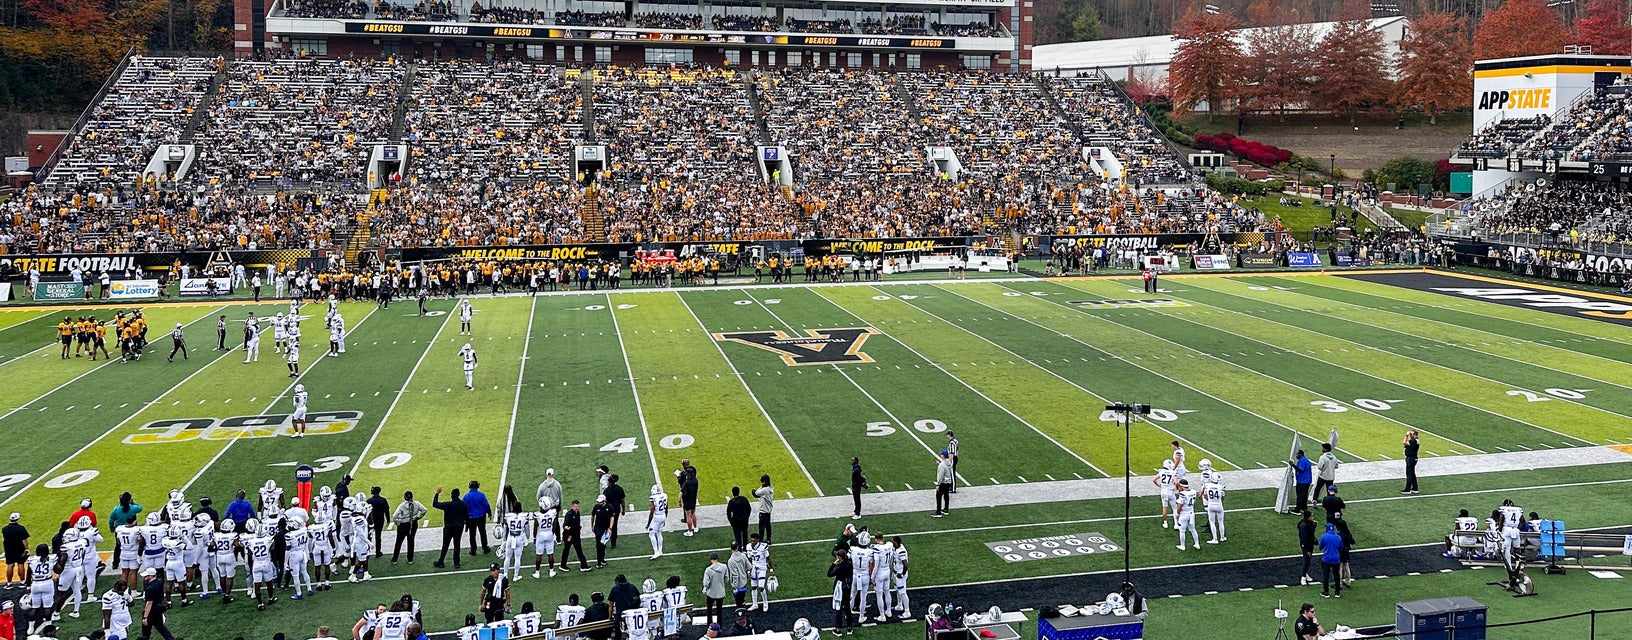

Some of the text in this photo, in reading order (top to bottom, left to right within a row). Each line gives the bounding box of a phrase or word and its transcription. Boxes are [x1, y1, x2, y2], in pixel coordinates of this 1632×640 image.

[363, 24, 404, 32] #BEATGSU
[428, 26, 469, 34] #BEATGSU
[493, 28, 532, 36] #BEATGSU
[804, 38, 837, 46] #BEATGSU
[858, 38, 890, 46] #BEATGSU
[910, 40, 942, 48] #BEATGSU
[1593, 164, 1605, 174] 25
[905, 240, 935, 252] ROCK
[526, 250, 535, 258] TO
[551, 247, 586, 260] ROCK
[1506, 388, 1586, 402] 20
[1310, 398, 1393, 413] 30
[866, 419, 948, 438] 50
[599, 433, 696, 453] 40
[1161, 474, 1172, 484] 27
[1208, 490, 1220, 500] 94
[322, 503, 328, 512] 4
[540, 518, 552, 529] 28
[1510, 513, 1516, 524] 4
[510, 520, 522, 530] 54
[122, 536, 130, 544] 11
[150, 534, 157, 544] 8
[315, 531, 325, 542] 21
[218, 540, 230, 551] 23
[254, 545, 268, 558] 22
[858, 556, 862, 568] 1
[34, 562, 50, 574] 43
[672, 592, 682, 605] 17
[650, 600, 657, 612] 6
[386, 616, 402, 628] 52
[568, 614, 576, 626] 8
[632, 614, 644, 630] 10
[526, 620, 534, 634] 5
